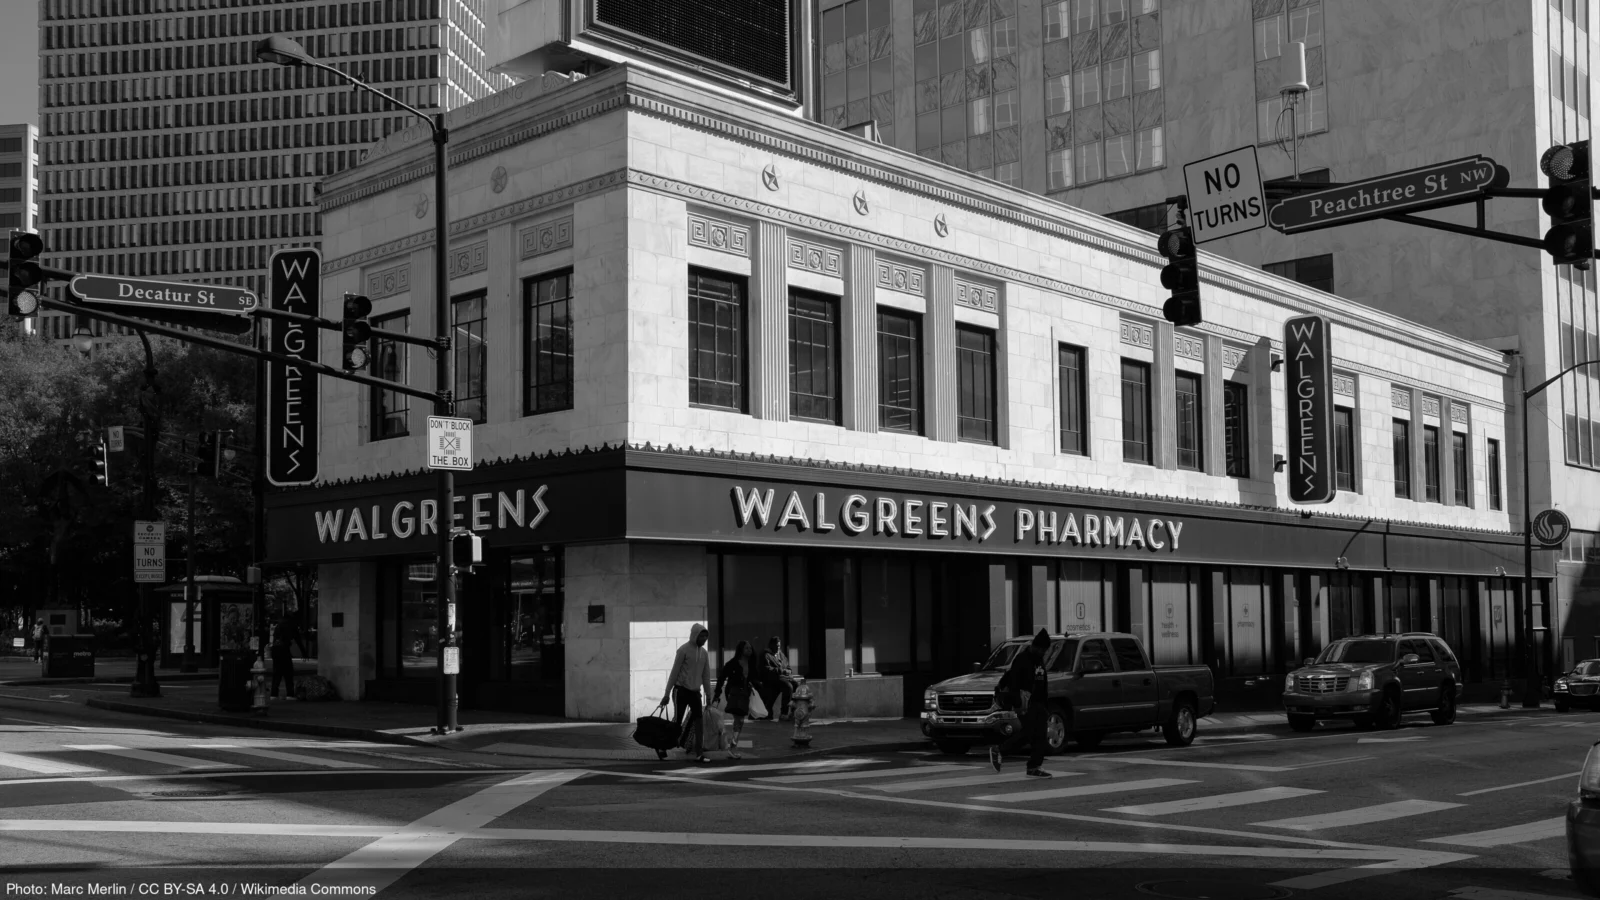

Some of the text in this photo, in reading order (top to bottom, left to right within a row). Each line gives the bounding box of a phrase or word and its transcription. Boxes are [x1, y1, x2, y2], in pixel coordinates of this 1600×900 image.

[465, 85, 523, 119] BUILDING
[1204, 163, 1240, 195] NO
[1309, 167, 1487, 218] Peachtree St NW
[1193, 196, 1261, 231] TURNS
[118, 282, 252, 306] Decatur St SE
[281, 257, 311, 475] WALGREENS
[430, 419, 470, 431] DON'T BLOCK
[1291, 321, 1317, 496] WALGREENS
[112, 430, 119, 439] NO
[432, 455, 469, 467] THE BOX
[314, 484, 550, 544] WALGREENS
[732, 486, 1184, 551] WALGREENS PHARMACY
[136, 558, 163, 567] TURNS
[144, 547, 155, 556] NO
